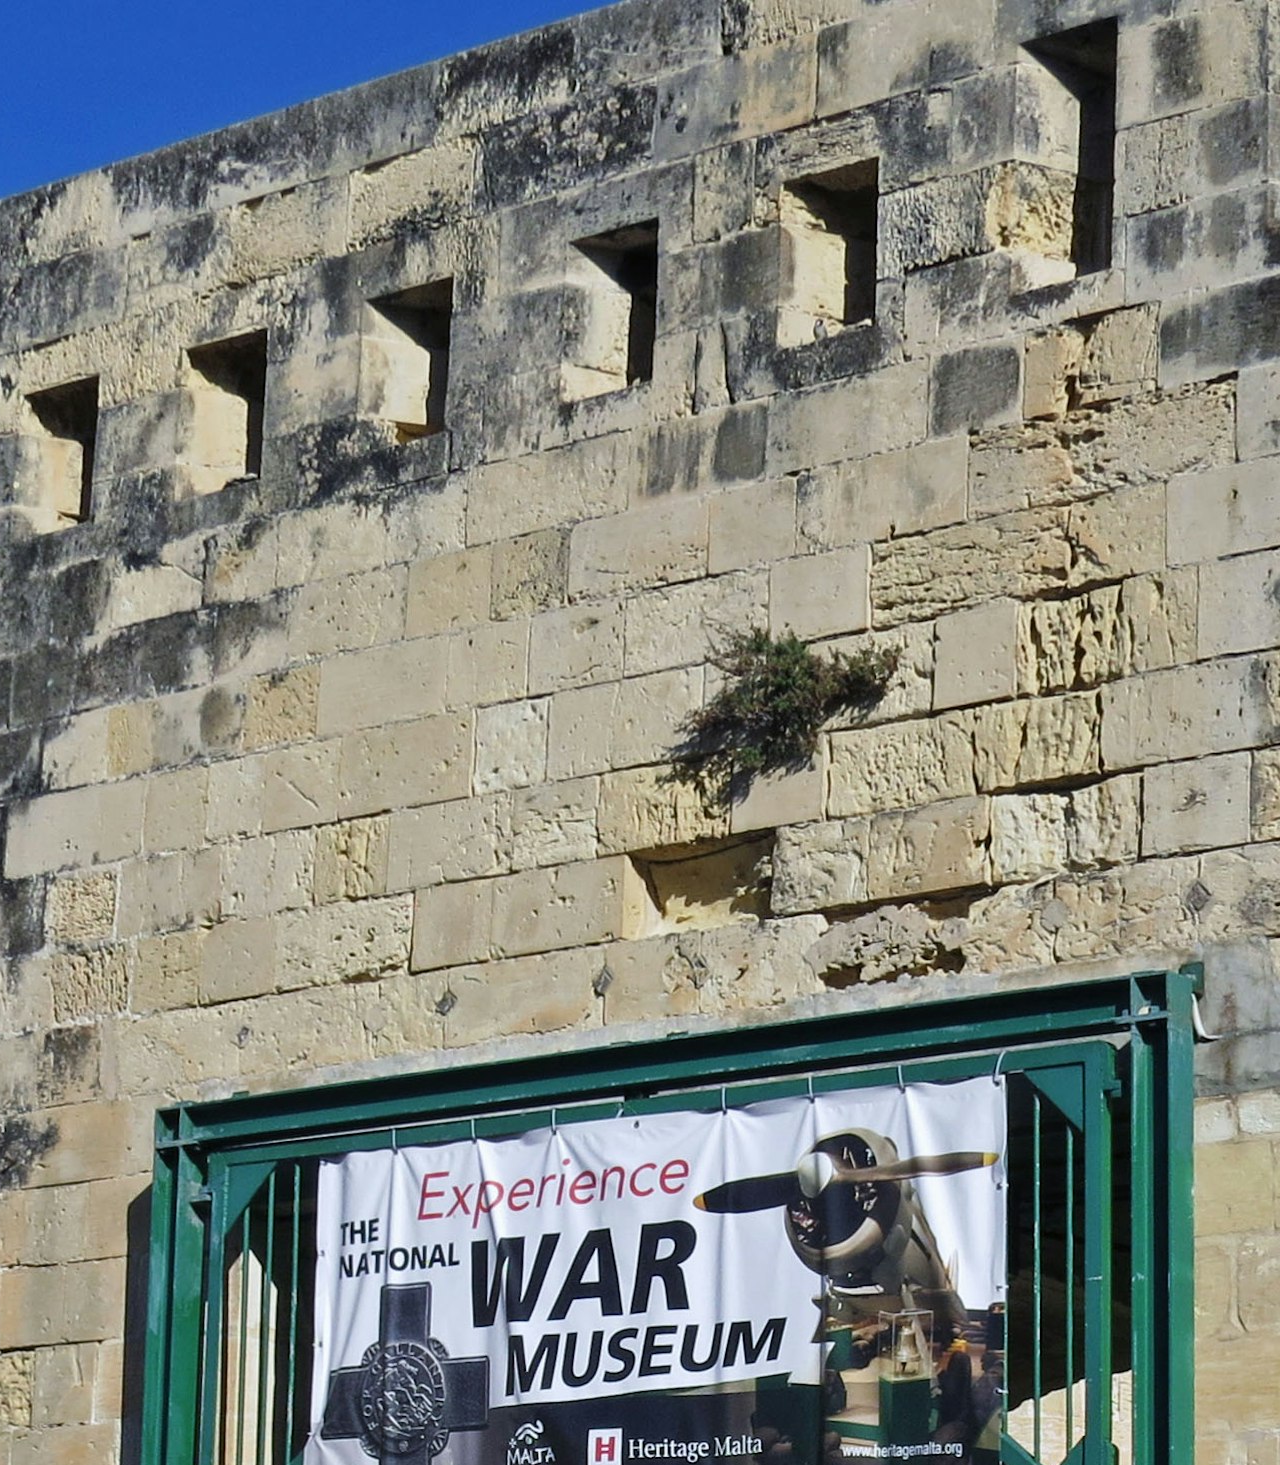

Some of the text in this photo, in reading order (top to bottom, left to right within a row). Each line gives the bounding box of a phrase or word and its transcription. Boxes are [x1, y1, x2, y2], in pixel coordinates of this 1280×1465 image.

[417, 1157, 689, 1229] Experience
[340, 1217, 379, 1246] THE
[339, 1241, 460, 1278] NATIONAL
[470, 1220, 697, 1328] WAR
[505, 1317, 788, 1396] MUSEUM
[628, 1434, 763, 1463] Heritage Malta
[841, 1440, 964, 1460] www.heritagemalta.org
